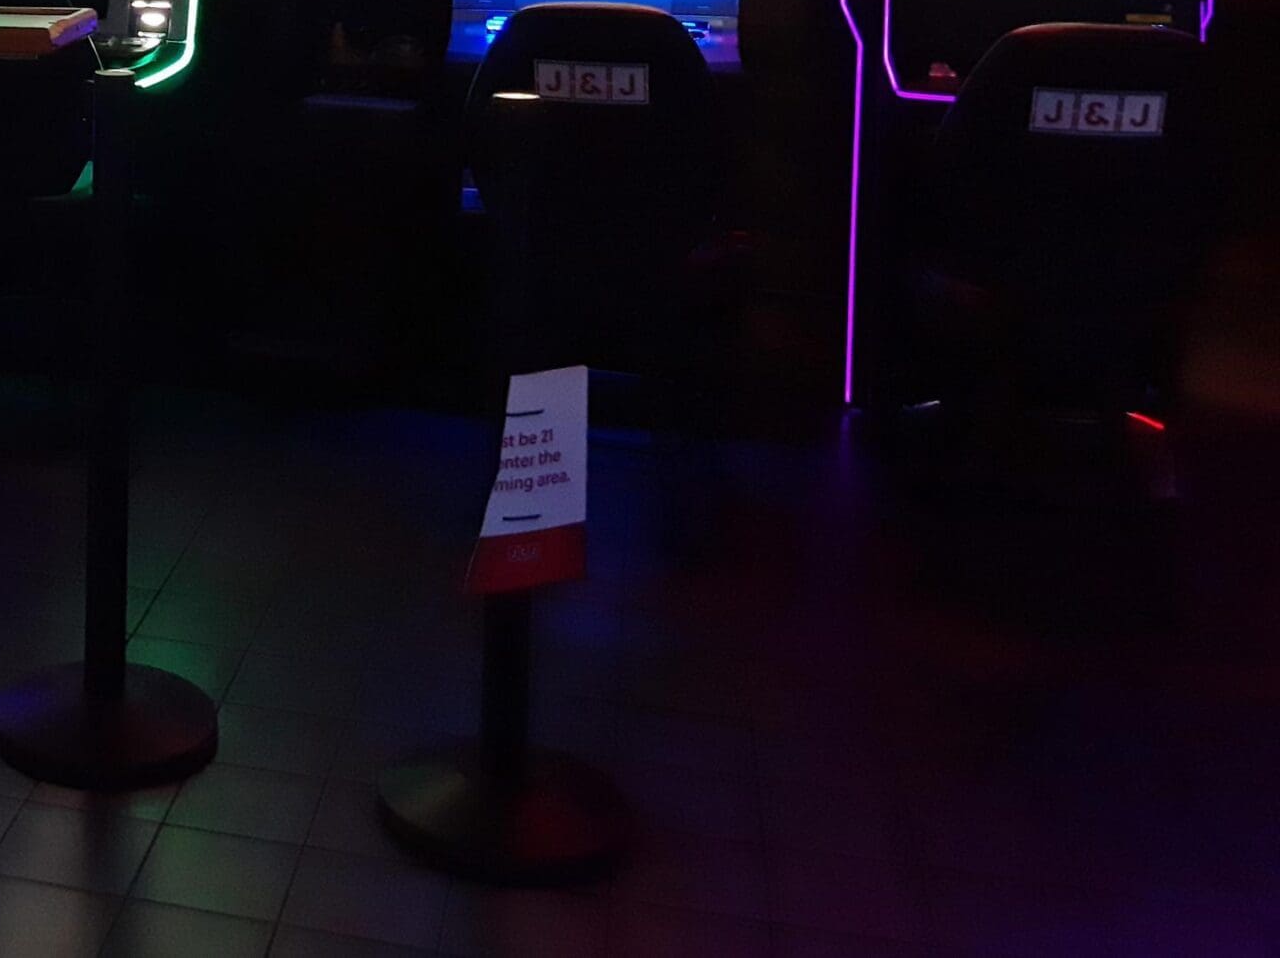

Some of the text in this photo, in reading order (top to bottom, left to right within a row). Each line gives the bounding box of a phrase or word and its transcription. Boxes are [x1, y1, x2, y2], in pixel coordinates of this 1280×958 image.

[501, 428, 554, 450] st be 21
[539, 450, 562, 466] the
[494, 470, 571, 493] ming area.
